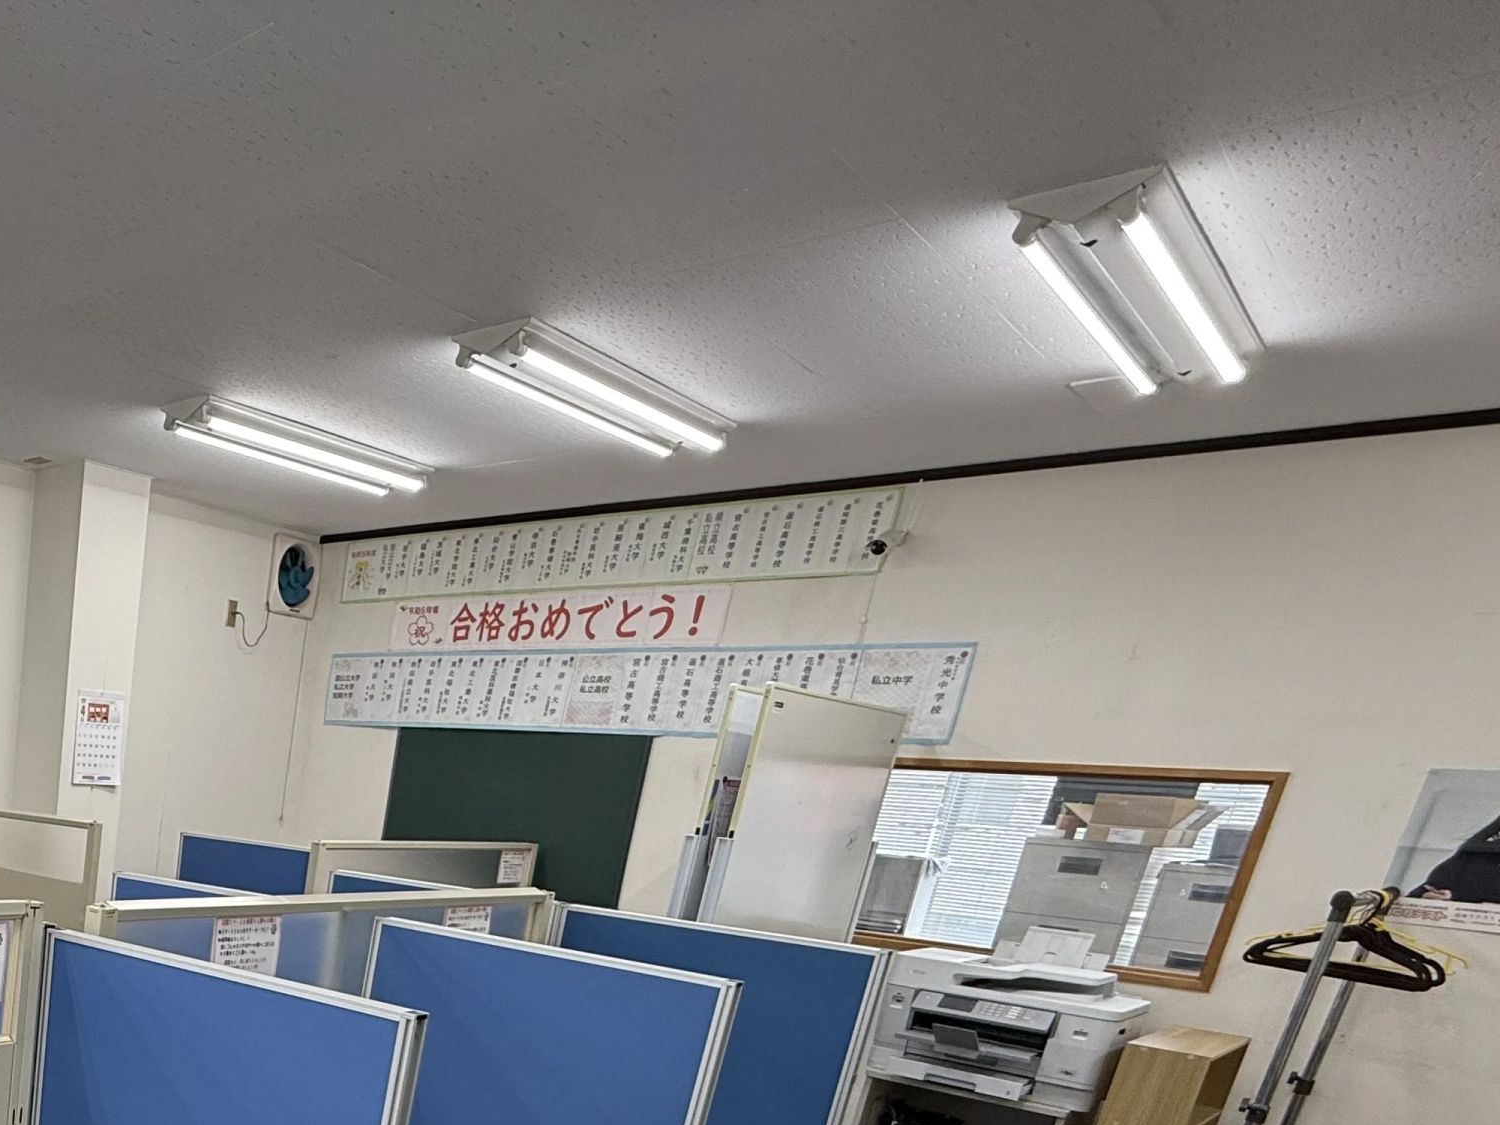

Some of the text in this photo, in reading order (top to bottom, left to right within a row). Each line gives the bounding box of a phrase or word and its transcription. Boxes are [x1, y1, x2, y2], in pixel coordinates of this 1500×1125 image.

[450, 594, 706, 642] 合格おめでとう！
[414, 625, 427, 638] 祝
[582, 675, 612, 683] 公立高校
[870, 675, 913, 686] 私立中学
[579, 685, 610, 693] 私立高校
[620, 657, 641, 724] 宮古高等学校
[676, 657, 697, 719] 釜石高等学校
